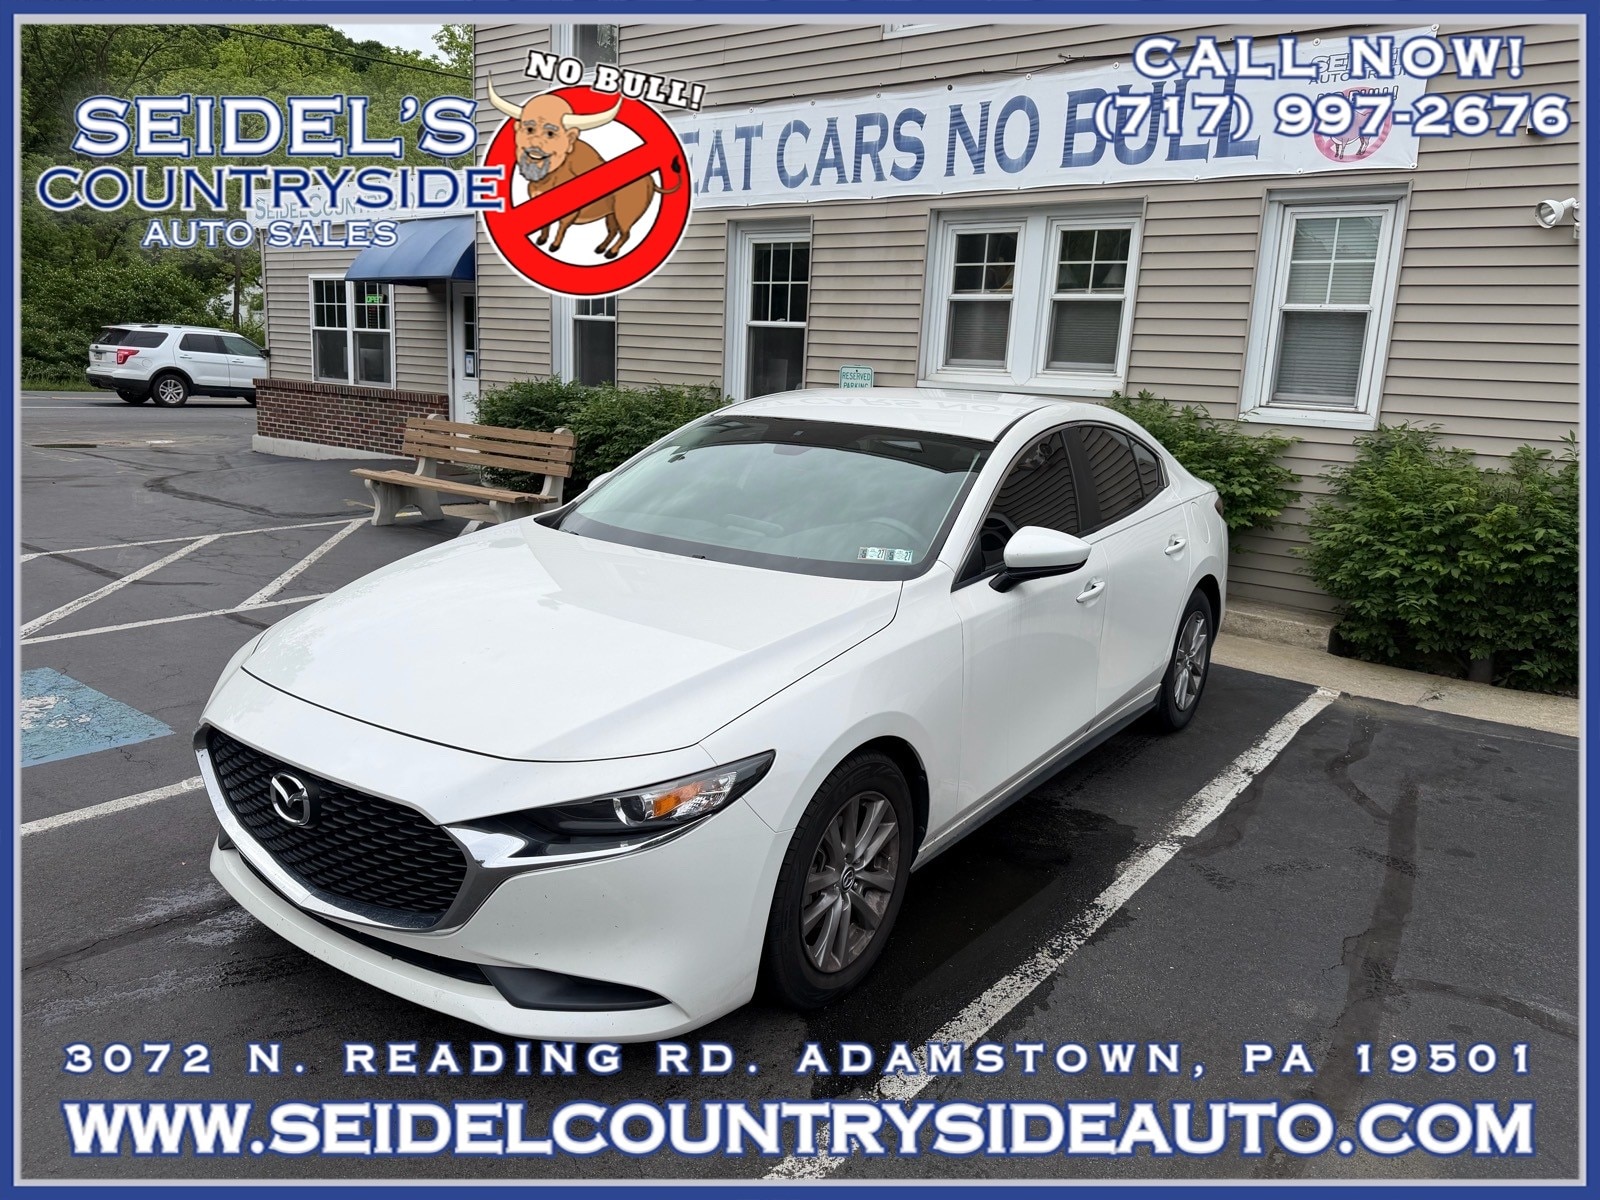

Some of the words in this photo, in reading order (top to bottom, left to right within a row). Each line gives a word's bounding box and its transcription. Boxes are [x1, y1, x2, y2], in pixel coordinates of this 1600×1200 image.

[776, 107, 927, 189] CARS
[944, 93, 1040, 178] NO
[1059, 72, 1261, 168] BULL
[842, 371, 871, 381] RESERVED
[877, 549, 885, 558] 27
[904, 551, 911, 560] 27
